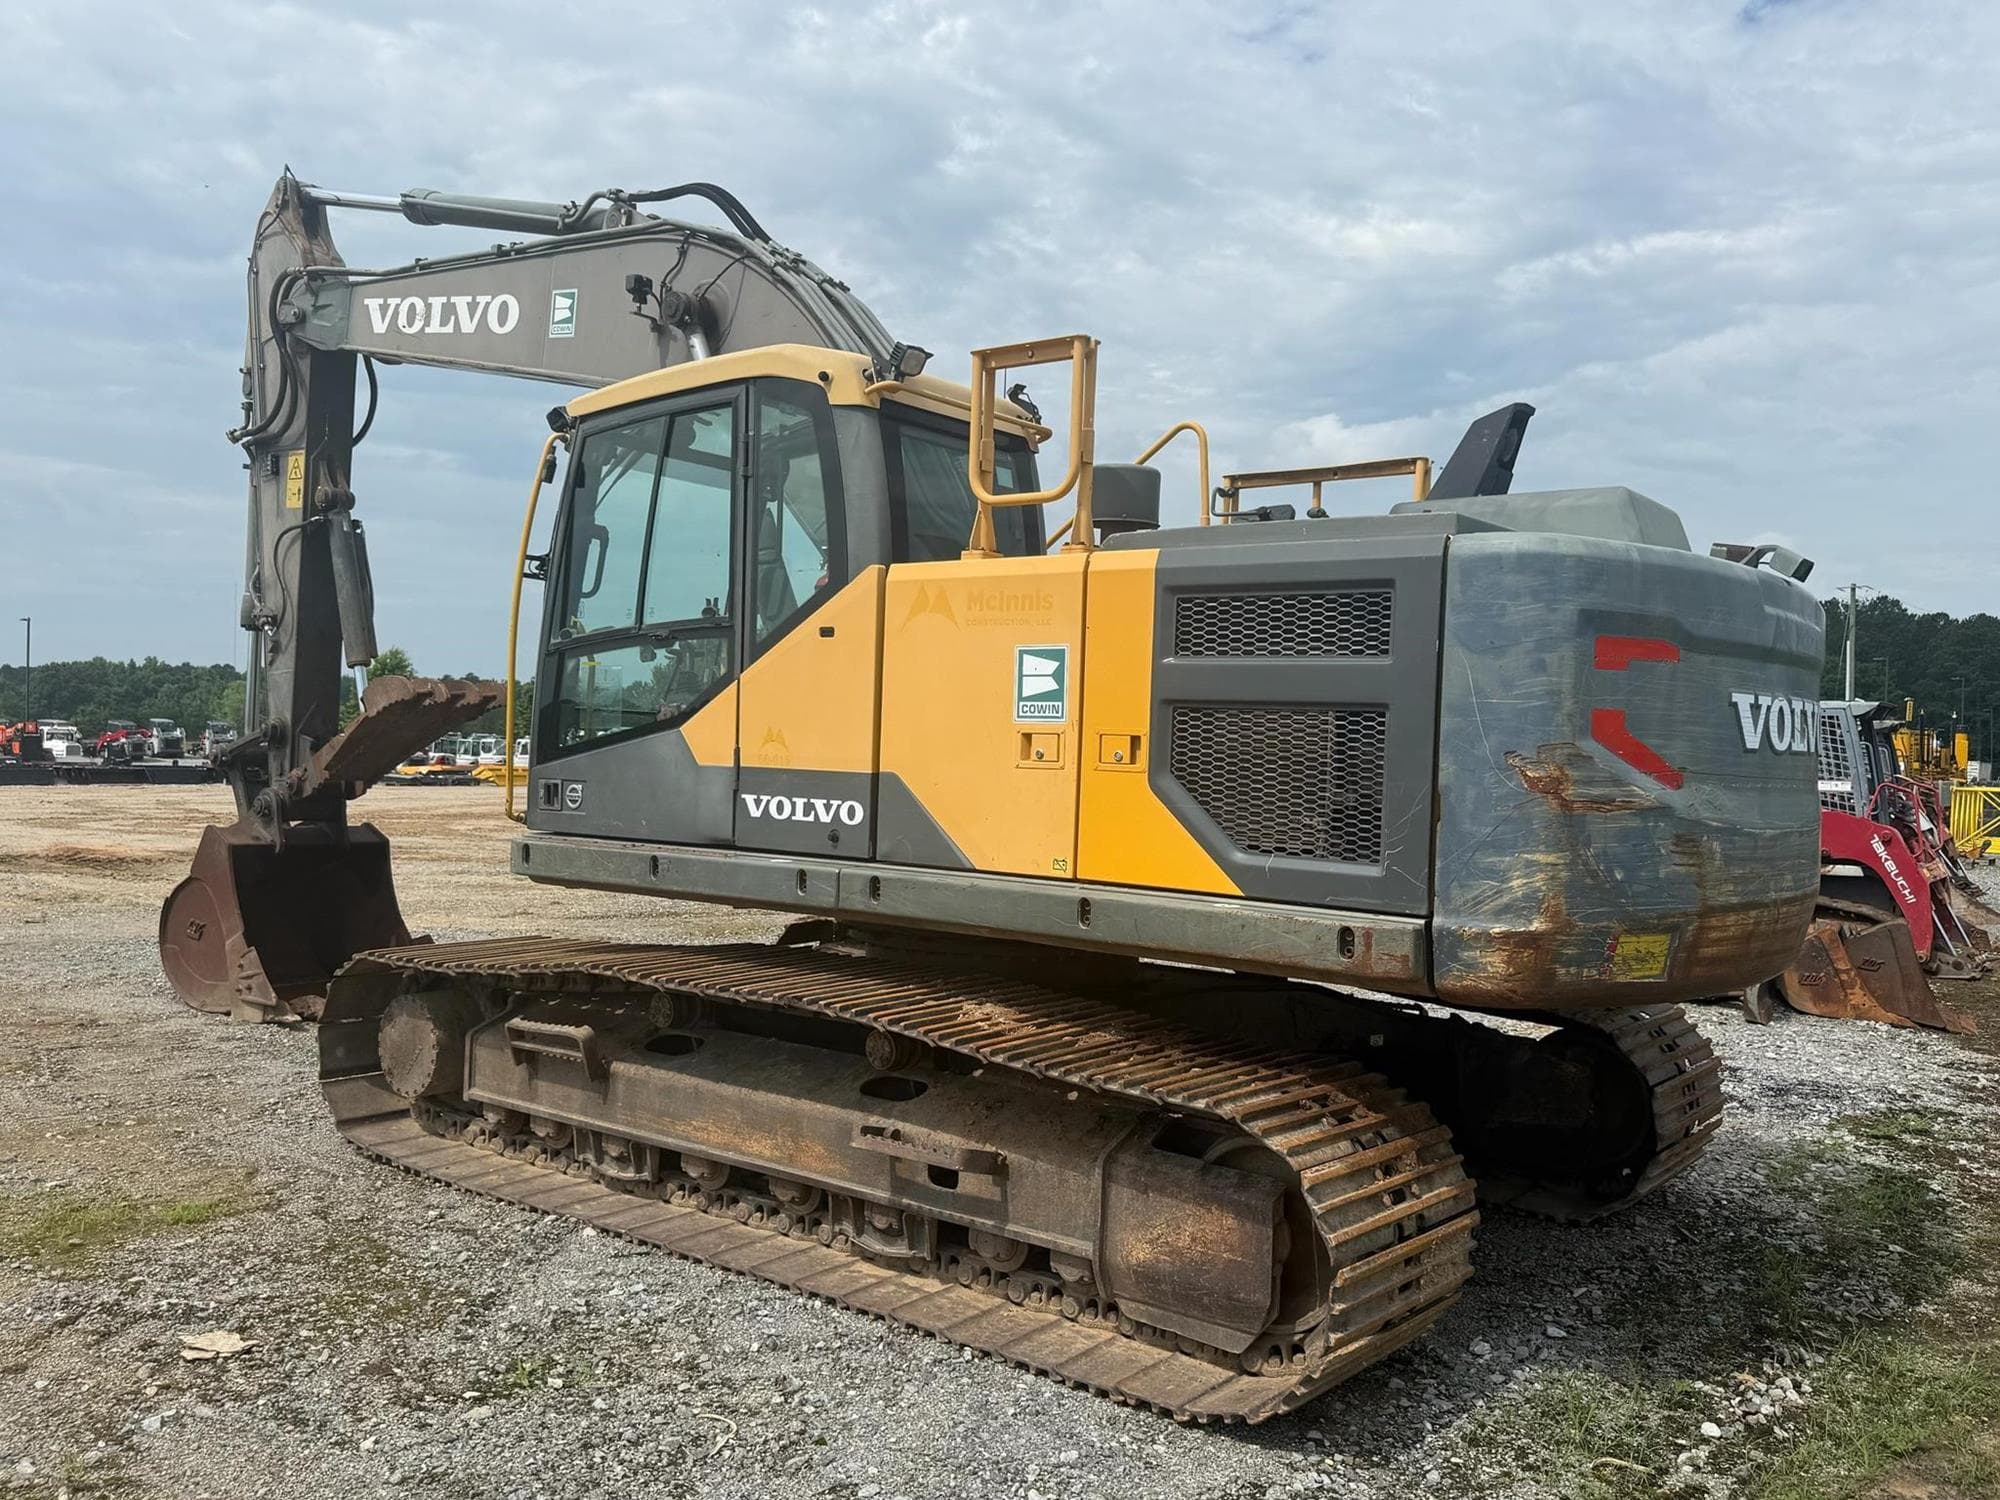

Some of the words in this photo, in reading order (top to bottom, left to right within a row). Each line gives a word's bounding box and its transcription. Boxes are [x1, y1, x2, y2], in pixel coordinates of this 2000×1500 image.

[364, 294, 520, 334] VOLVO
[966, 589, 1054, 612] McInnis
[1021, 703, 1060, 715] COWIN
[1731, 692, 1820, 753] VOLV
[741, 793, 864, 826] VOLVO
